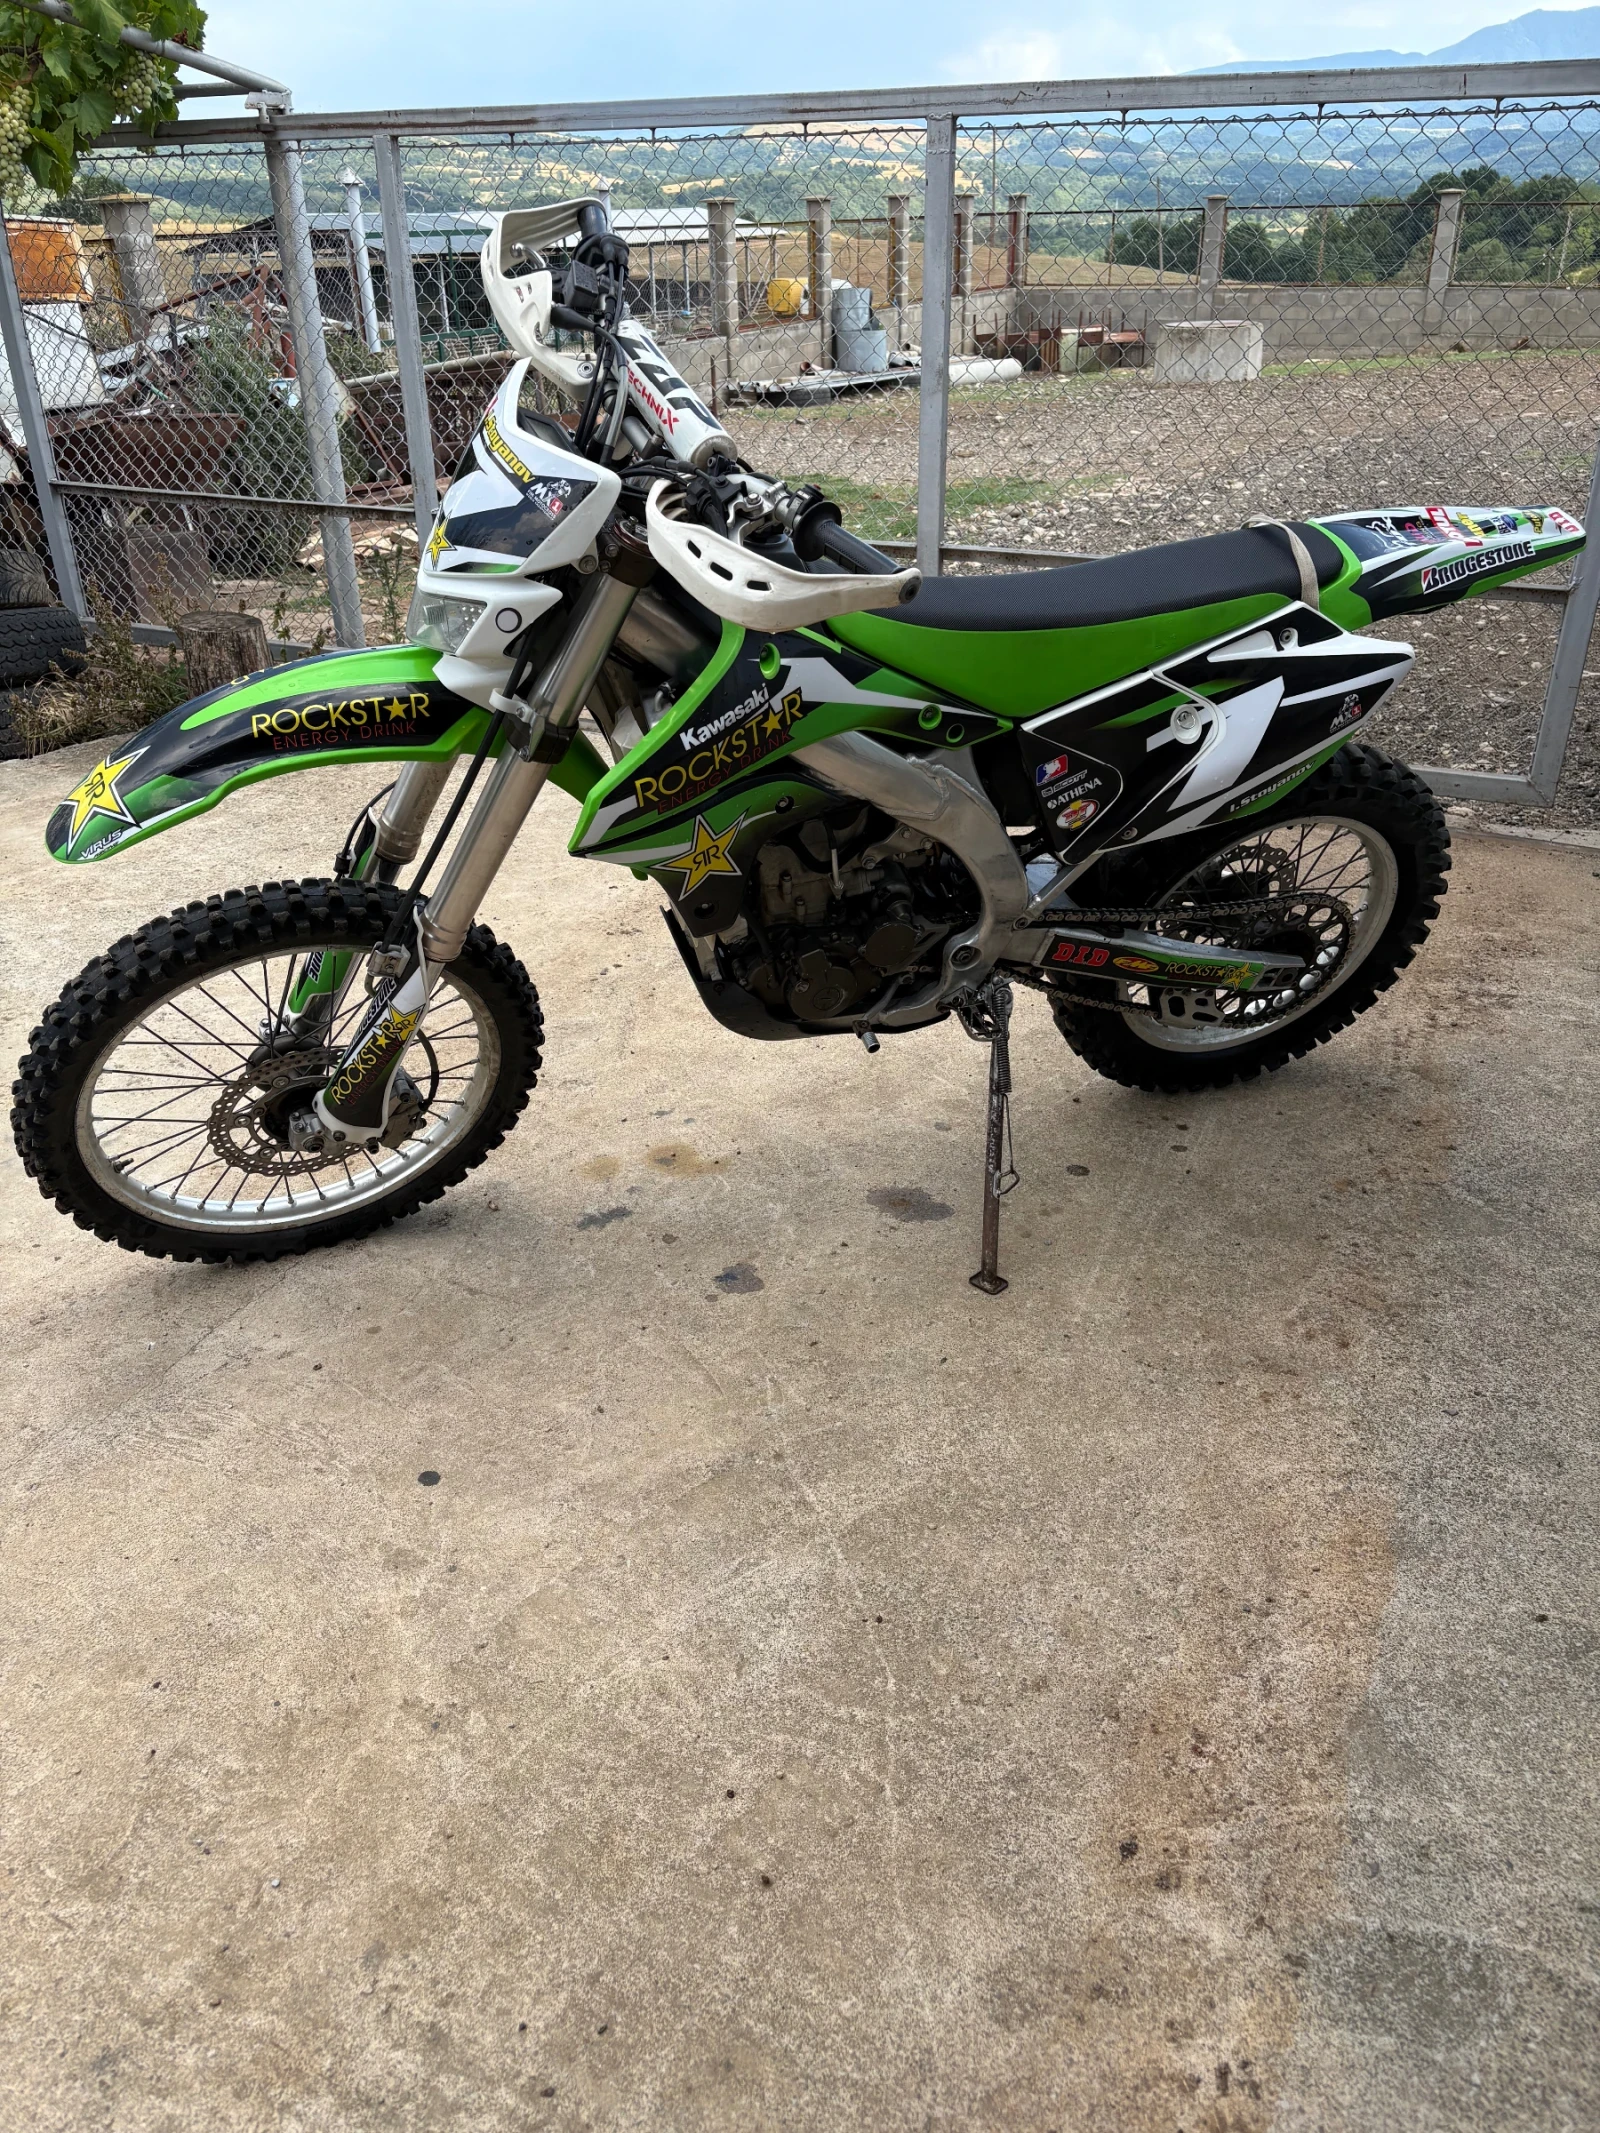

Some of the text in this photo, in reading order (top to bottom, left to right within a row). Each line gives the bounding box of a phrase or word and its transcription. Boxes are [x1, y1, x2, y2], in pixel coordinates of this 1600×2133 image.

[626, 360, 680, 436] ECHNIX
[1423, 540, 1535, 593] BRIDGESTONE
[273, 720, 417, 751] ENERGY DRINK
[679, 682, 770, 751] Kawasaki
[657, 728, 794, 814] ENERGY DRINK
[1057, 777, 1103, 806] ATHENA
[80, 828, 123, 859] VIRUS
[346, 1070, 378, 1106] ENERGY
